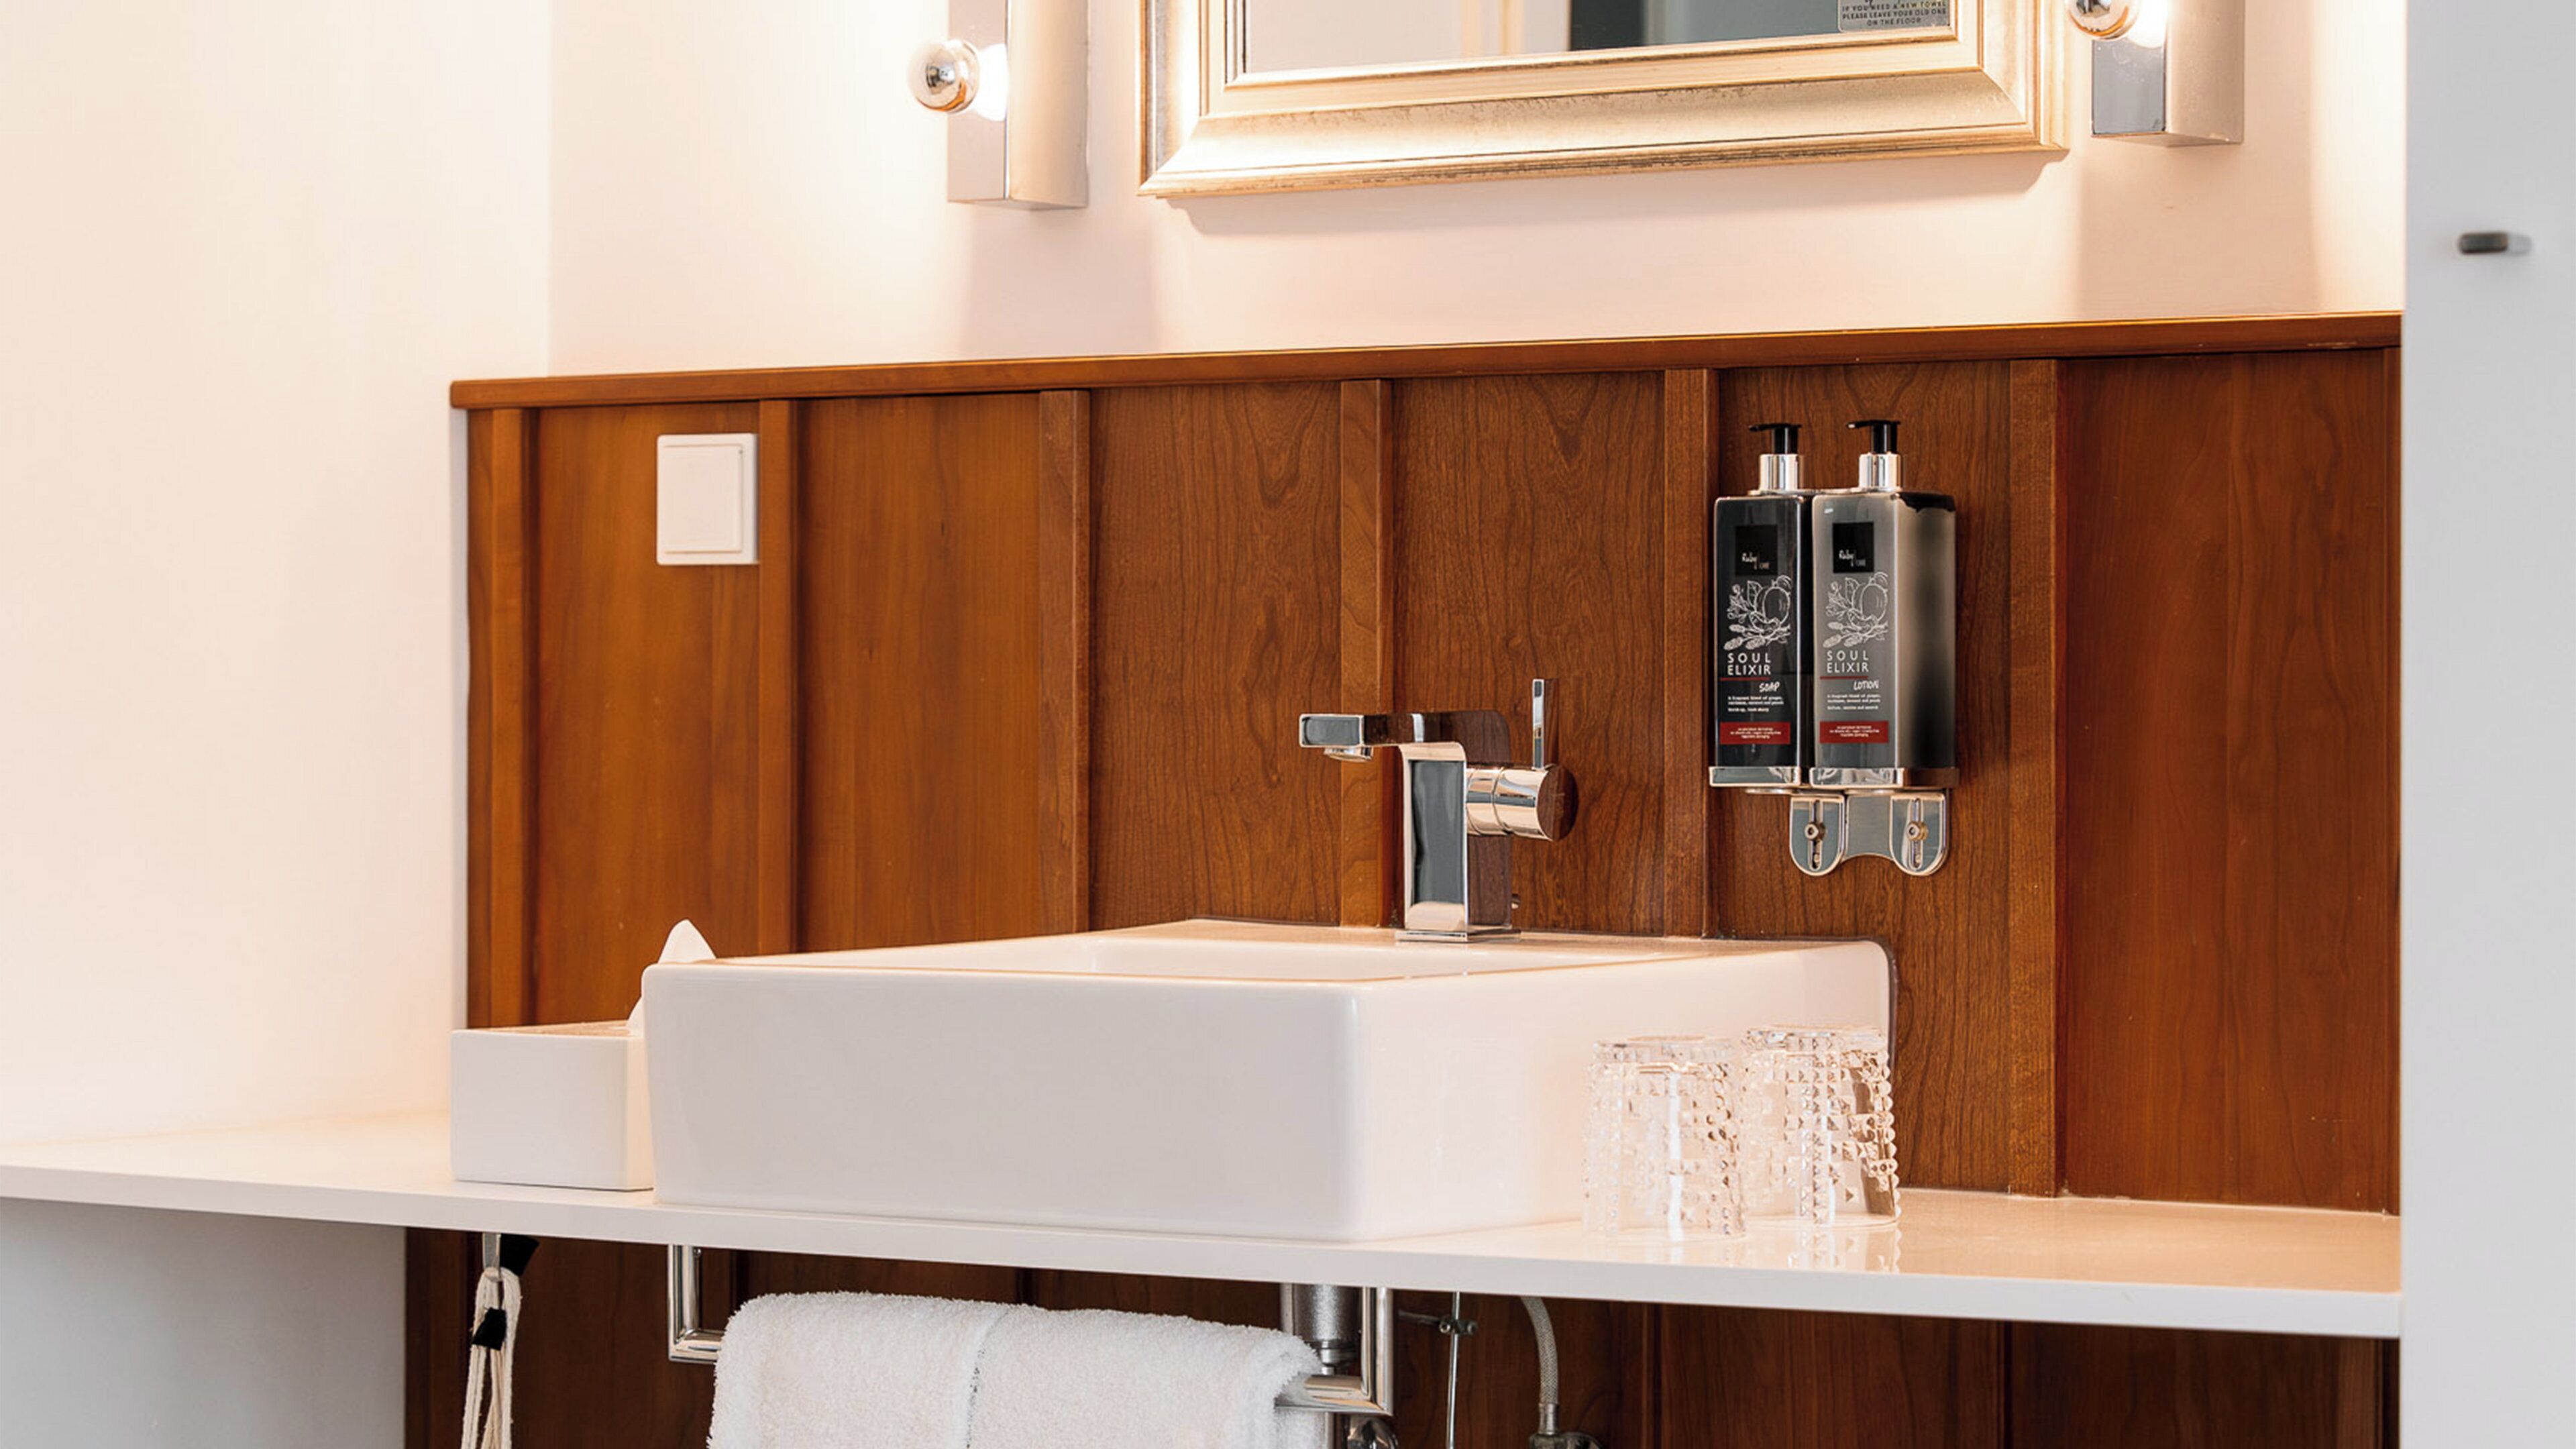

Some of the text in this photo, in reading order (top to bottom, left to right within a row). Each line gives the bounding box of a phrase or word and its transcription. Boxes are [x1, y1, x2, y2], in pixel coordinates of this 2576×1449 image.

[1843, 12, 1868, 20] PLEASE
[1727, 653, 1771, 663] SOUL
[1827, 650, 1869, 661] SOUL
[1727, 664, 1771, 676] ELIXIR
[1827, 662, 1869, 674] ELIXIR
[1759, 681, 1780, 693] SOAP
[1854, 680, 1880, 691] LOTION
